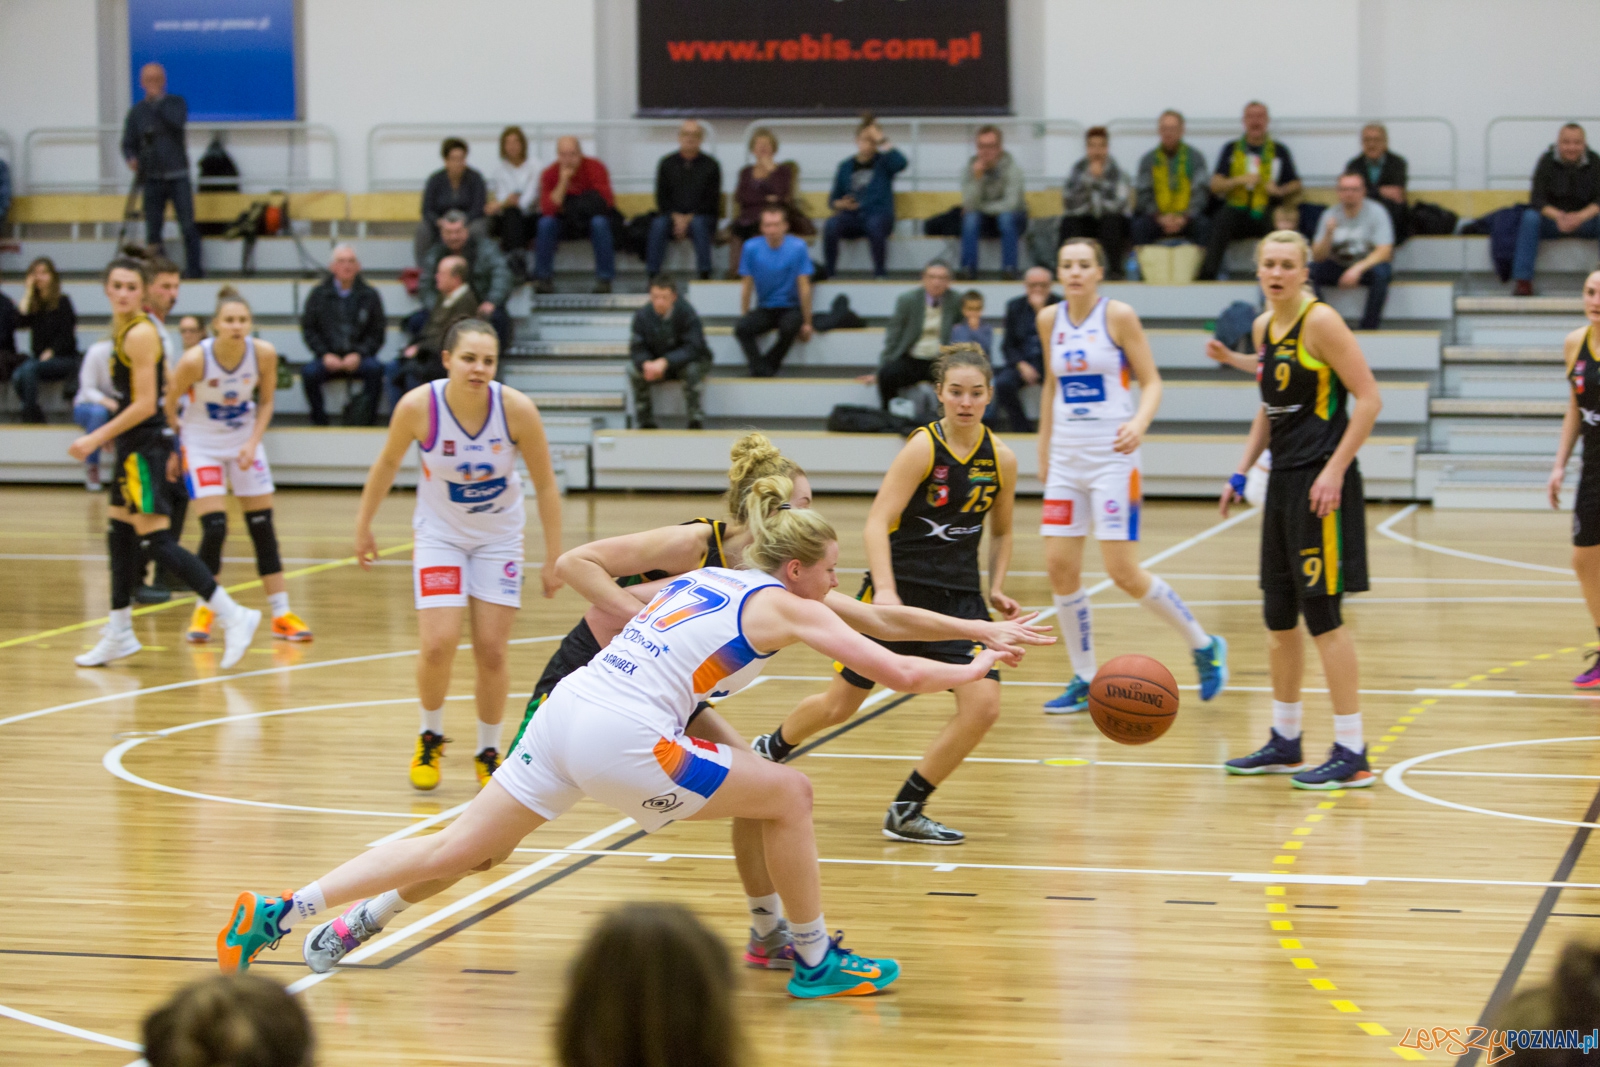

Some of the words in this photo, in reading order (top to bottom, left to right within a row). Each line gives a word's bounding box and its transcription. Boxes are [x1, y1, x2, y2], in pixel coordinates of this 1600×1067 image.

[666, 31, 982, 65] www.rebis.com.pl
[1063, 349, 1089, 372] 13
[1274, 361, 1291, 392] 9
[455, 461, 496, 481] 12
[959, 484, 998, 513] 15
[1302, 556, 1323, 588] 9
[634, 576, 731, 633] 17
[602, 652, 638, 676] AGROBEX
[1105, 683, 1164, 709] SPALDING
